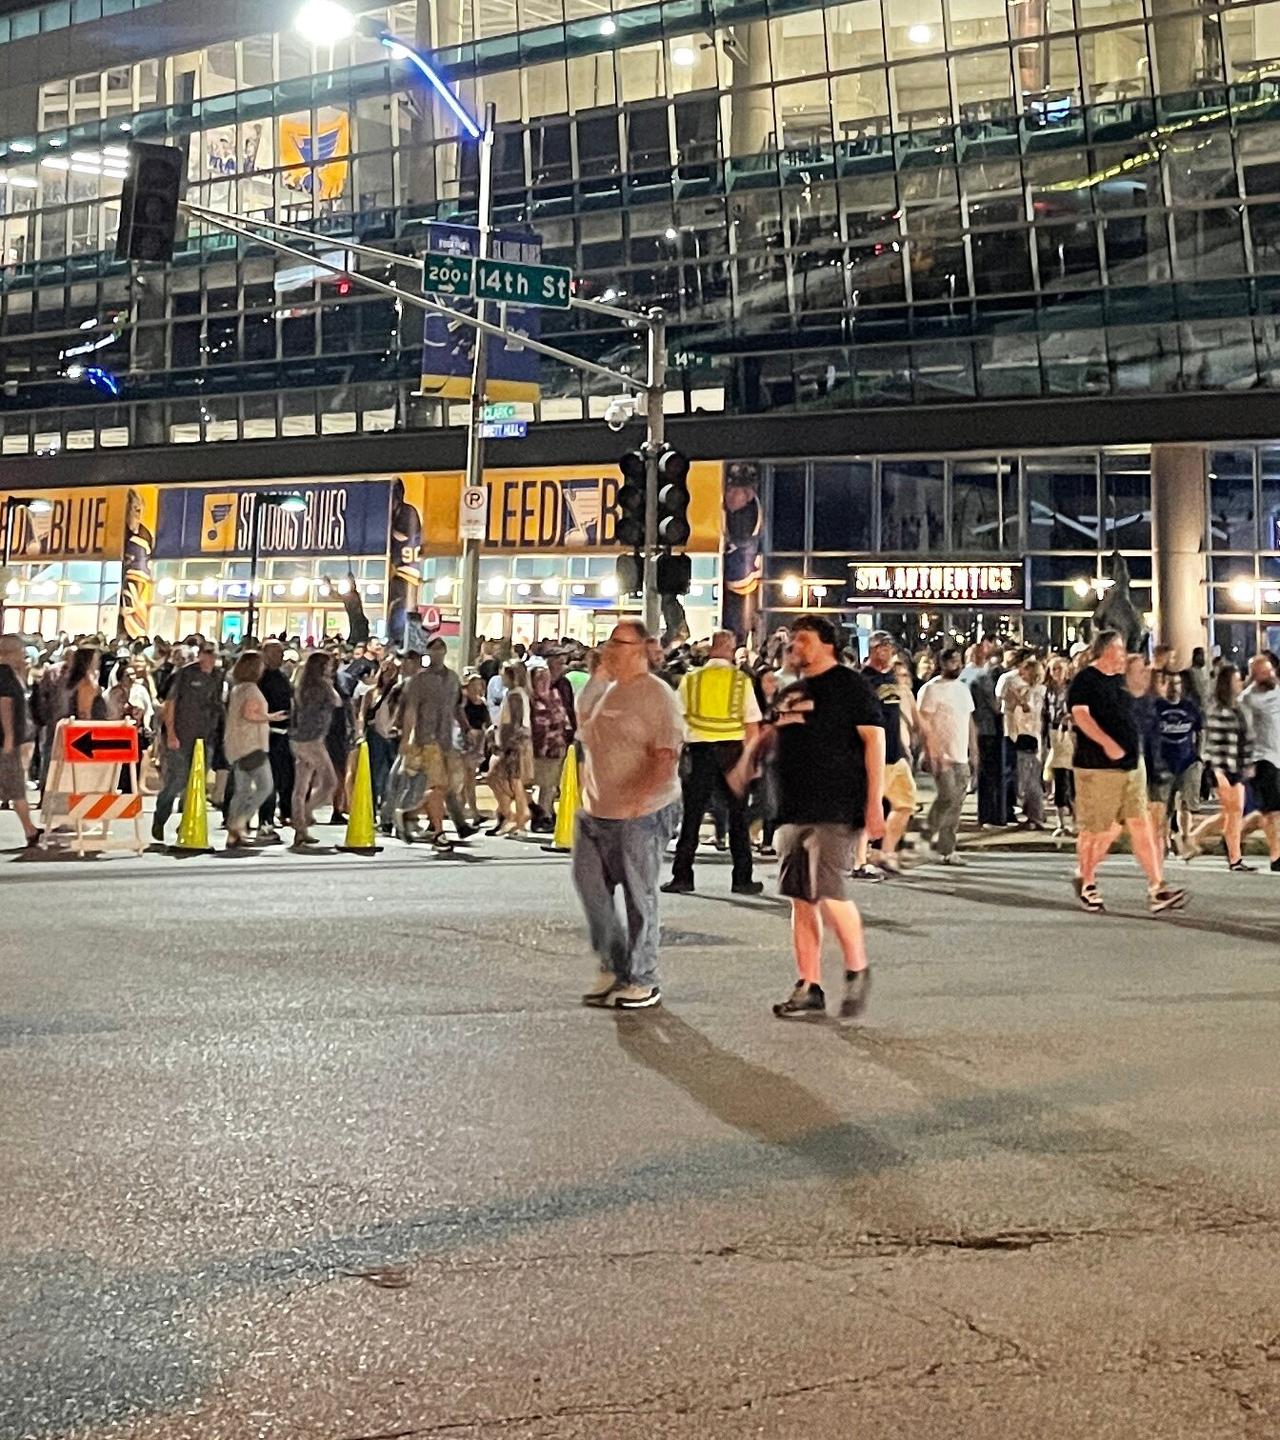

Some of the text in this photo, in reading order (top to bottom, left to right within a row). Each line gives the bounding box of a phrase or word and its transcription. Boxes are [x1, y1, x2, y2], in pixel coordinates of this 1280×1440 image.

[429, 266, 461, 284] 200
[479, 266, 567, 300] 14th St
[48, 497, 107, 554] BLUE
[301, 488, 347, 551] BLUES
[484, 478, 560, 548] LEED
